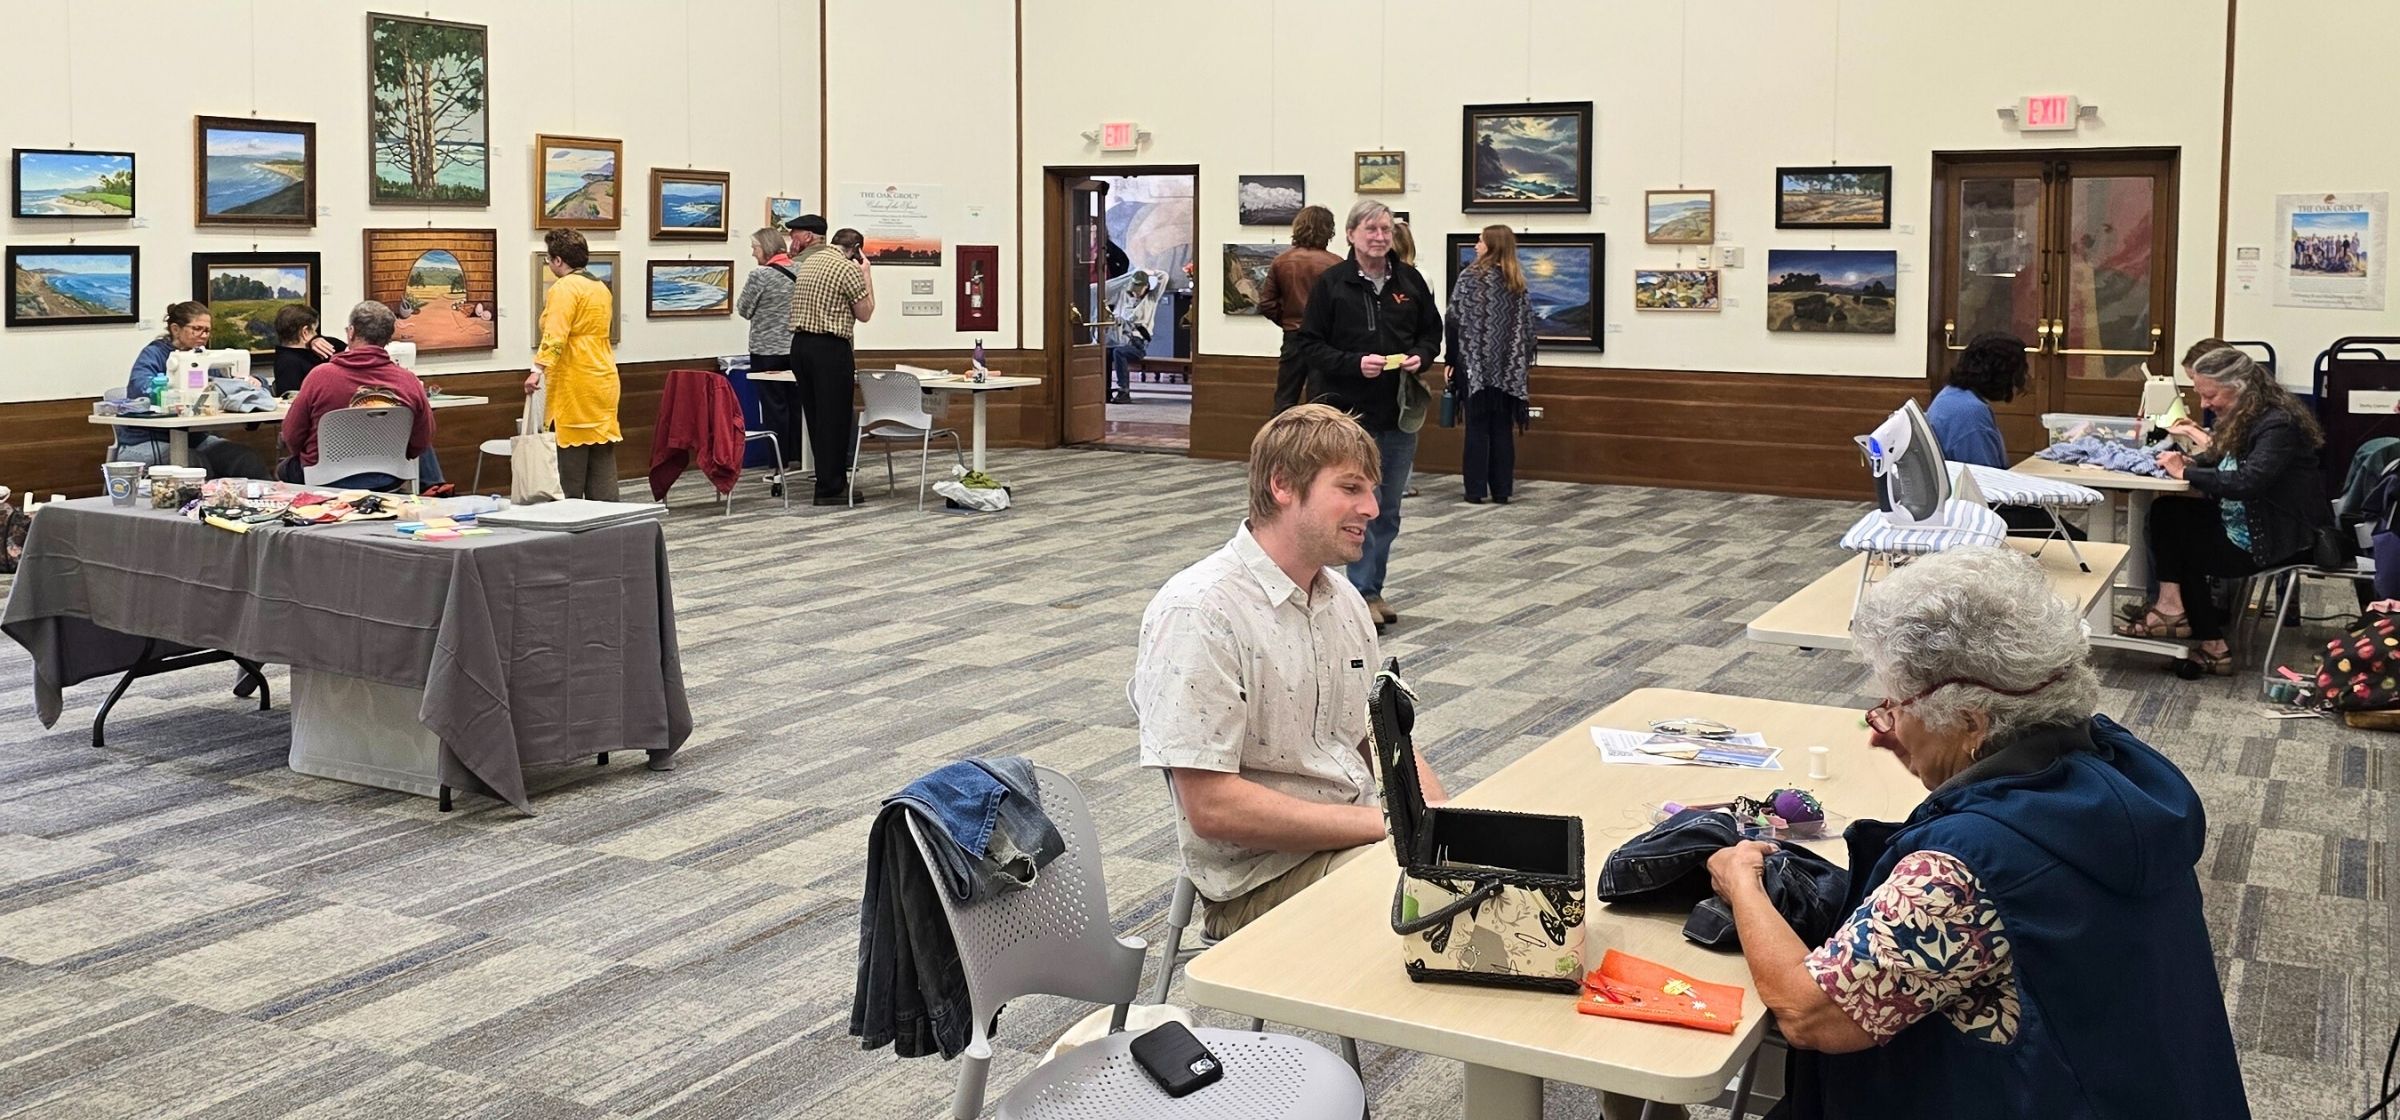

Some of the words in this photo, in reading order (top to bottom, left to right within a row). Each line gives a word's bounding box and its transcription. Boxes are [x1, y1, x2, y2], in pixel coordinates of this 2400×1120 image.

[2029, 97, 2068, 125] EXIT
[1105, 124, 1130, 147] EXIT
[2333, 204, 2363, 212] GROUP
